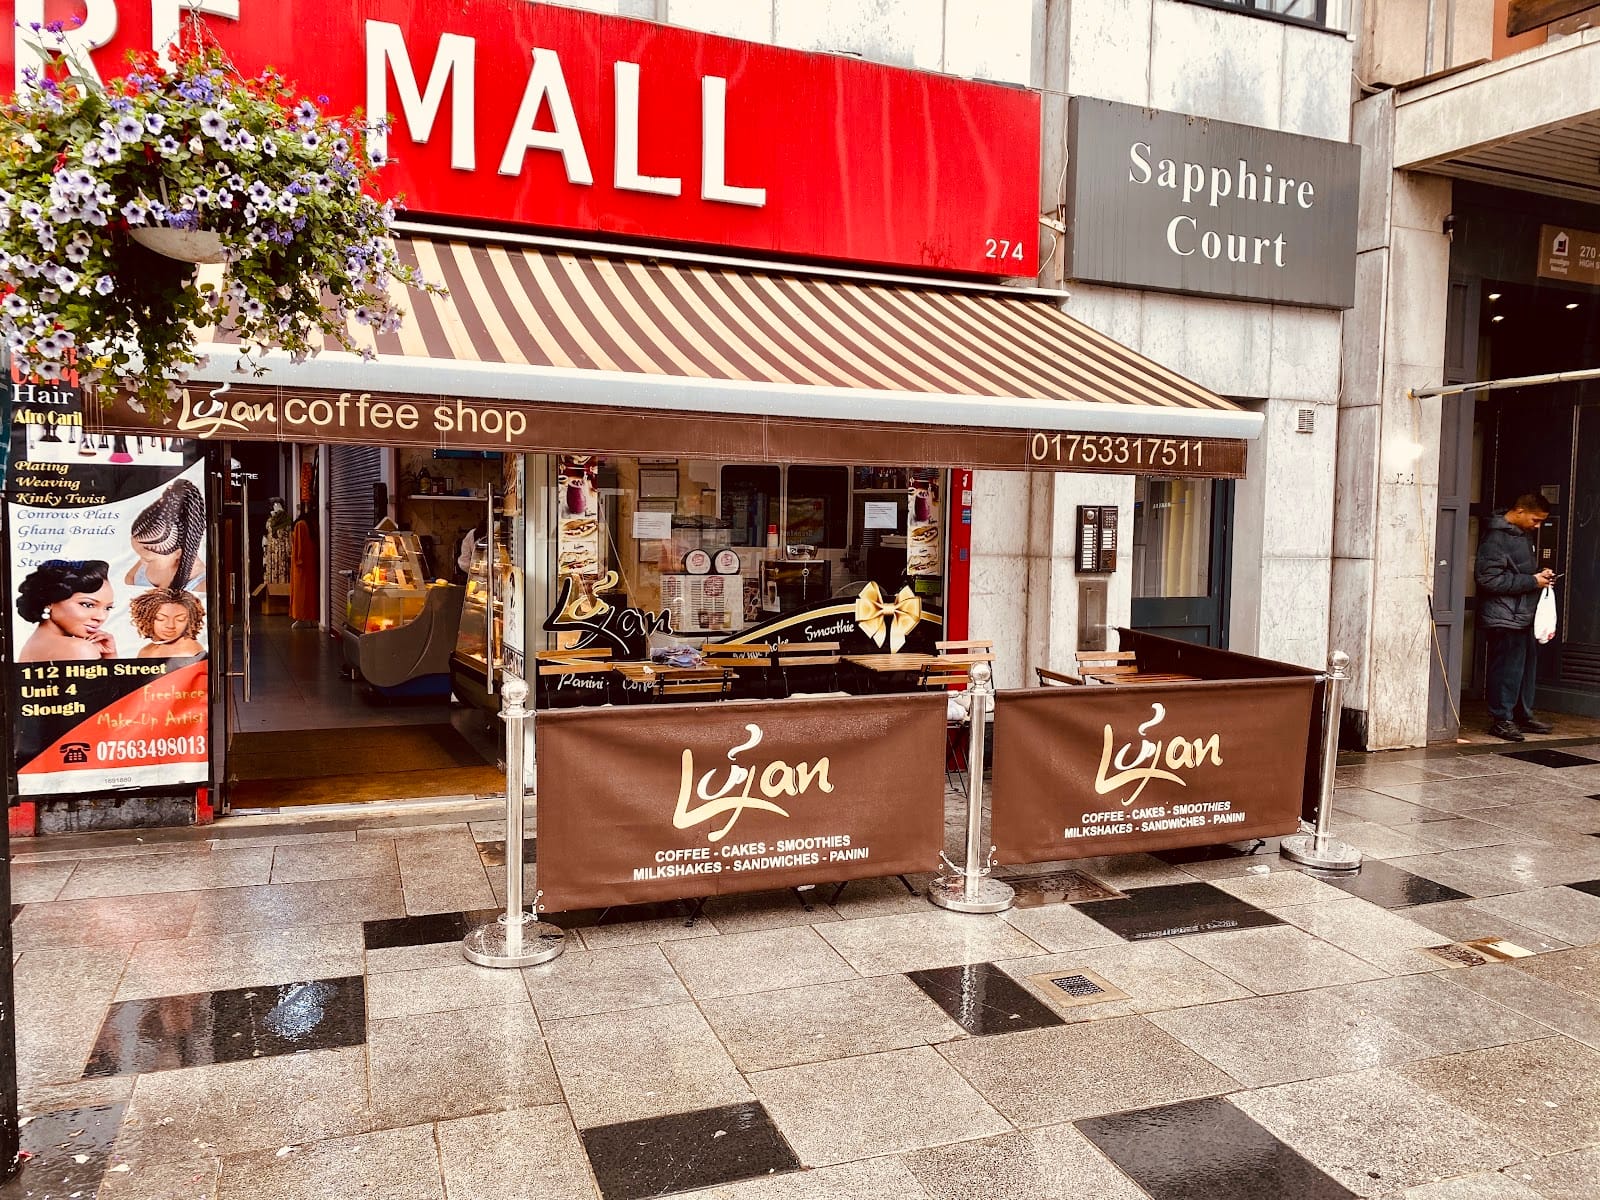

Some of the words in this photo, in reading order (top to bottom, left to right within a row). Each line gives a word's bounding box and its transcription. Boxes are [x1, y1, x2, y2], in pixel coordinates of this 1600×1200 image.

[365, 18, 767, 207] MALL
[1128, 141, 1316, 209] Sapphire
[985, 238, 1024, 262] 274
[1166, 215, 1288, 268] Court
[1580, 245, 1597, 259] 270
[11, 383, 74, 405] Hair
[14, 408, 46, 425] Afro
[177, 382, 277, 439] Lujan
[284, 393, 419, 430] coffee
[433, 399, 528, 443] shop
[1031, 432, 1204, 467] 01753317511
[15, 460, 70, 474] Plating
[15, 476, 81, 490] Weaving
[16, 492, 62, 507] Kinky
[65, 493, 107, 505] Twist
[17, 509, 80, 520] Conrows
[83, 509, 120, 520] Plats
[18, 524, 65, 538] Ghana
[69, 525, 116, 535] Braids
[17, 541, 63, 554] Dying
[804, 619, 856, 642] Smoothie
[21, 666, 60, 681] 112
[65, 664, 109, 680] High
[113, 662, 167, 676] Street
[557, 671, 605, 691] Panini
[21, 684, 60, 699] Unit
[64, 683, 79, 696] 4
[143, 683, 206, 704] Freelance
[21, 701, 86, 717] Slough
[97, 712, 159, 730] Make-Up
[164, 708, 206, 728] Artist
[96, 734, 207, 761] 07563498013
[1095, 702, 1224, 806] Lujan
[672, 723, 835, 842] Lujan
[1081, 810, 1125, 825] COFFEE
[1131, 806, 1166, 820] CAKES
[1172, 800, 1232, 816] SMOOTHIES
[1063, 822, 1133, 840] MILKSHAKES
[1141, 814, 1206, 833] SANDWICHES
[1213, 811, 1246, 824] PANINI
[654, 846, 711, 864] COFFEE
[721, 841, 767, 859] CAKES
[776, 834, 852, 852] SMOOTHIES
[632, 860, 723, 881] MILKSHAKES
[733, 851, 820, 873] SANDWICHES
[829, 846, 870, 862] PANINI
